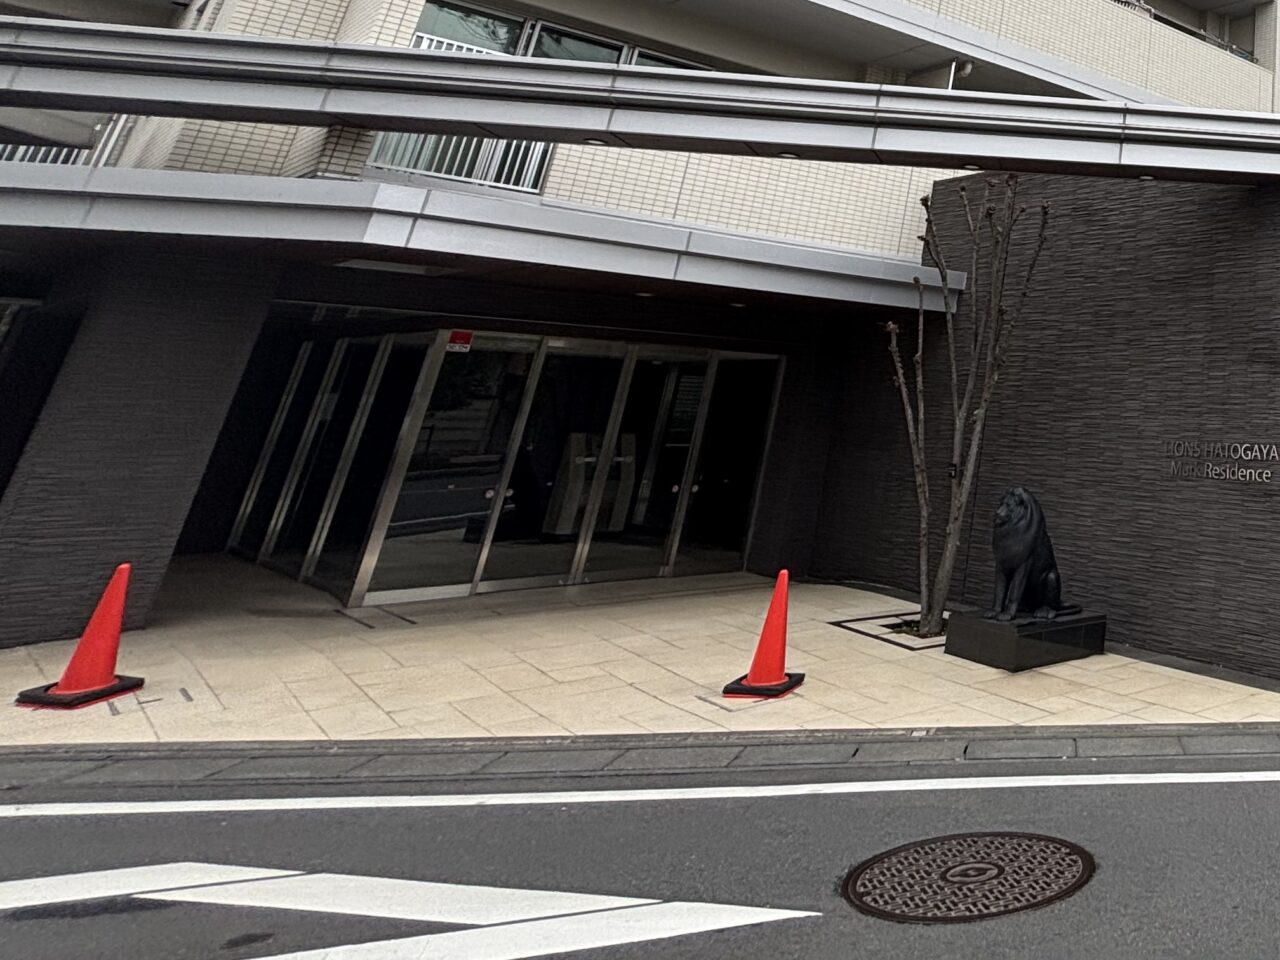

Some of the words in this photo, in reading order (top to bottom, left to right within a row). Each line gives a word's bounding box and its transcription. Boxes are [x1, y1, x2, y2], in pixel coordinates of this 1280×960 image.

[1164, 440, 1201, 457] LIONS
[1204, 442, 1279, 461] HATOGAYA
[1204, 462, 1272, 483] Residence
